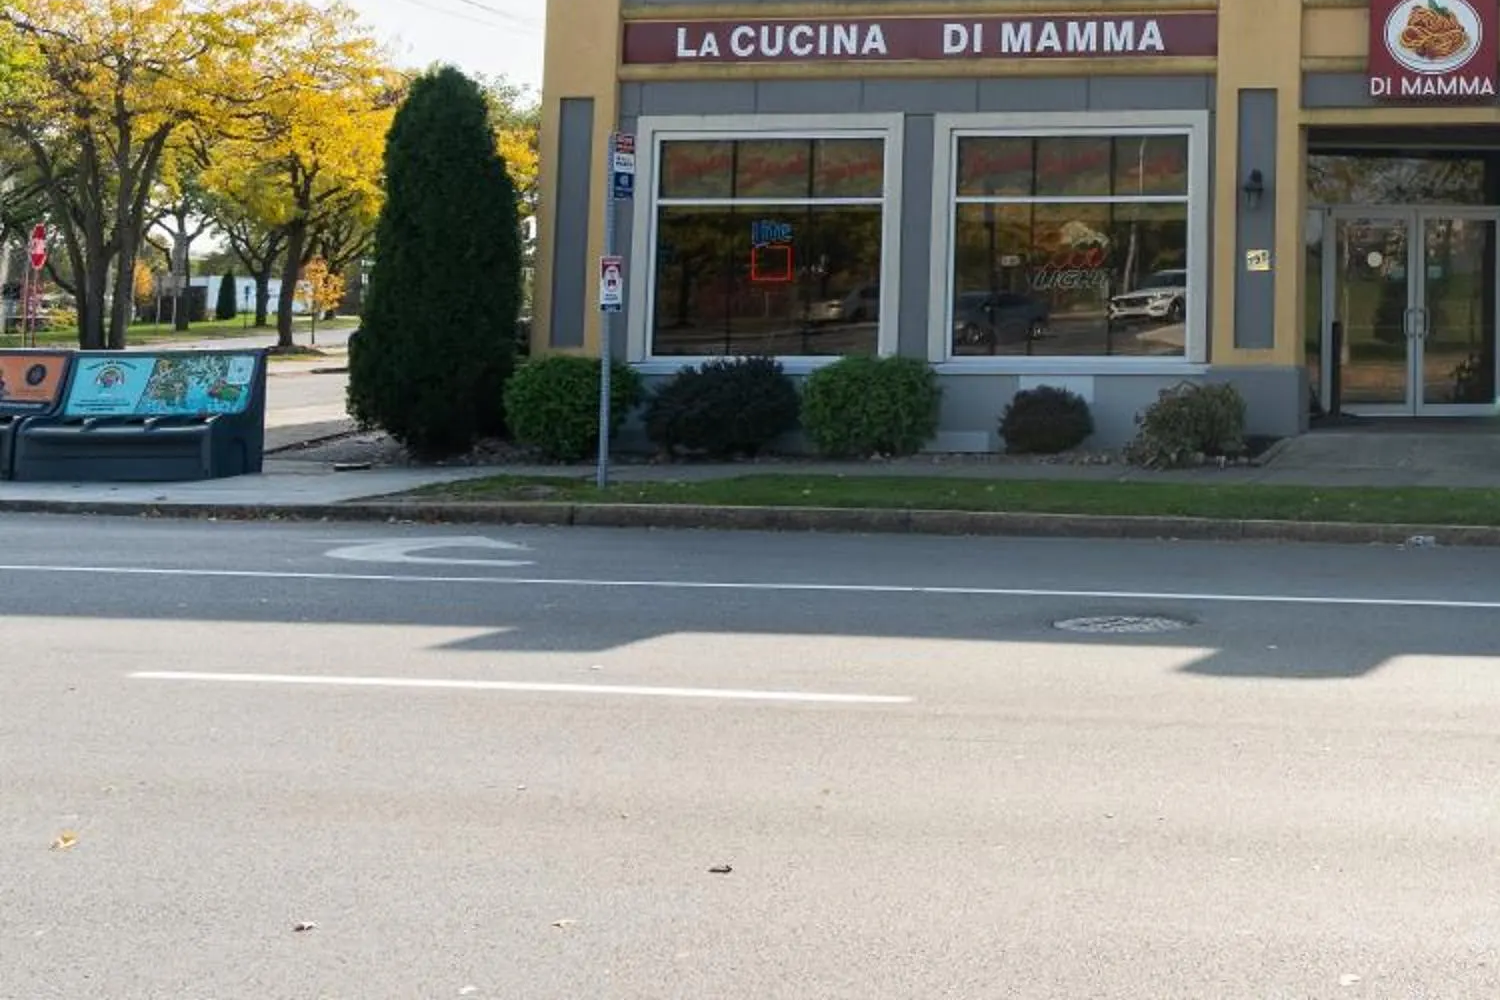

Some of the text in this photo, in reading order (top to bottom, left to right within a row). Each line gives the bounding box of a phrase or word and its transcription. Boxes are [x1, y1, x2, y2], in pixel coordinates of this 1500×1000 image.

[730, 23, 888, 57] CUCINA
[943, 23, 983, 54] DI
[1001, 19, 1165, 53] MAMMA
[1370, 75, 1495, 96] DI MAMMA
